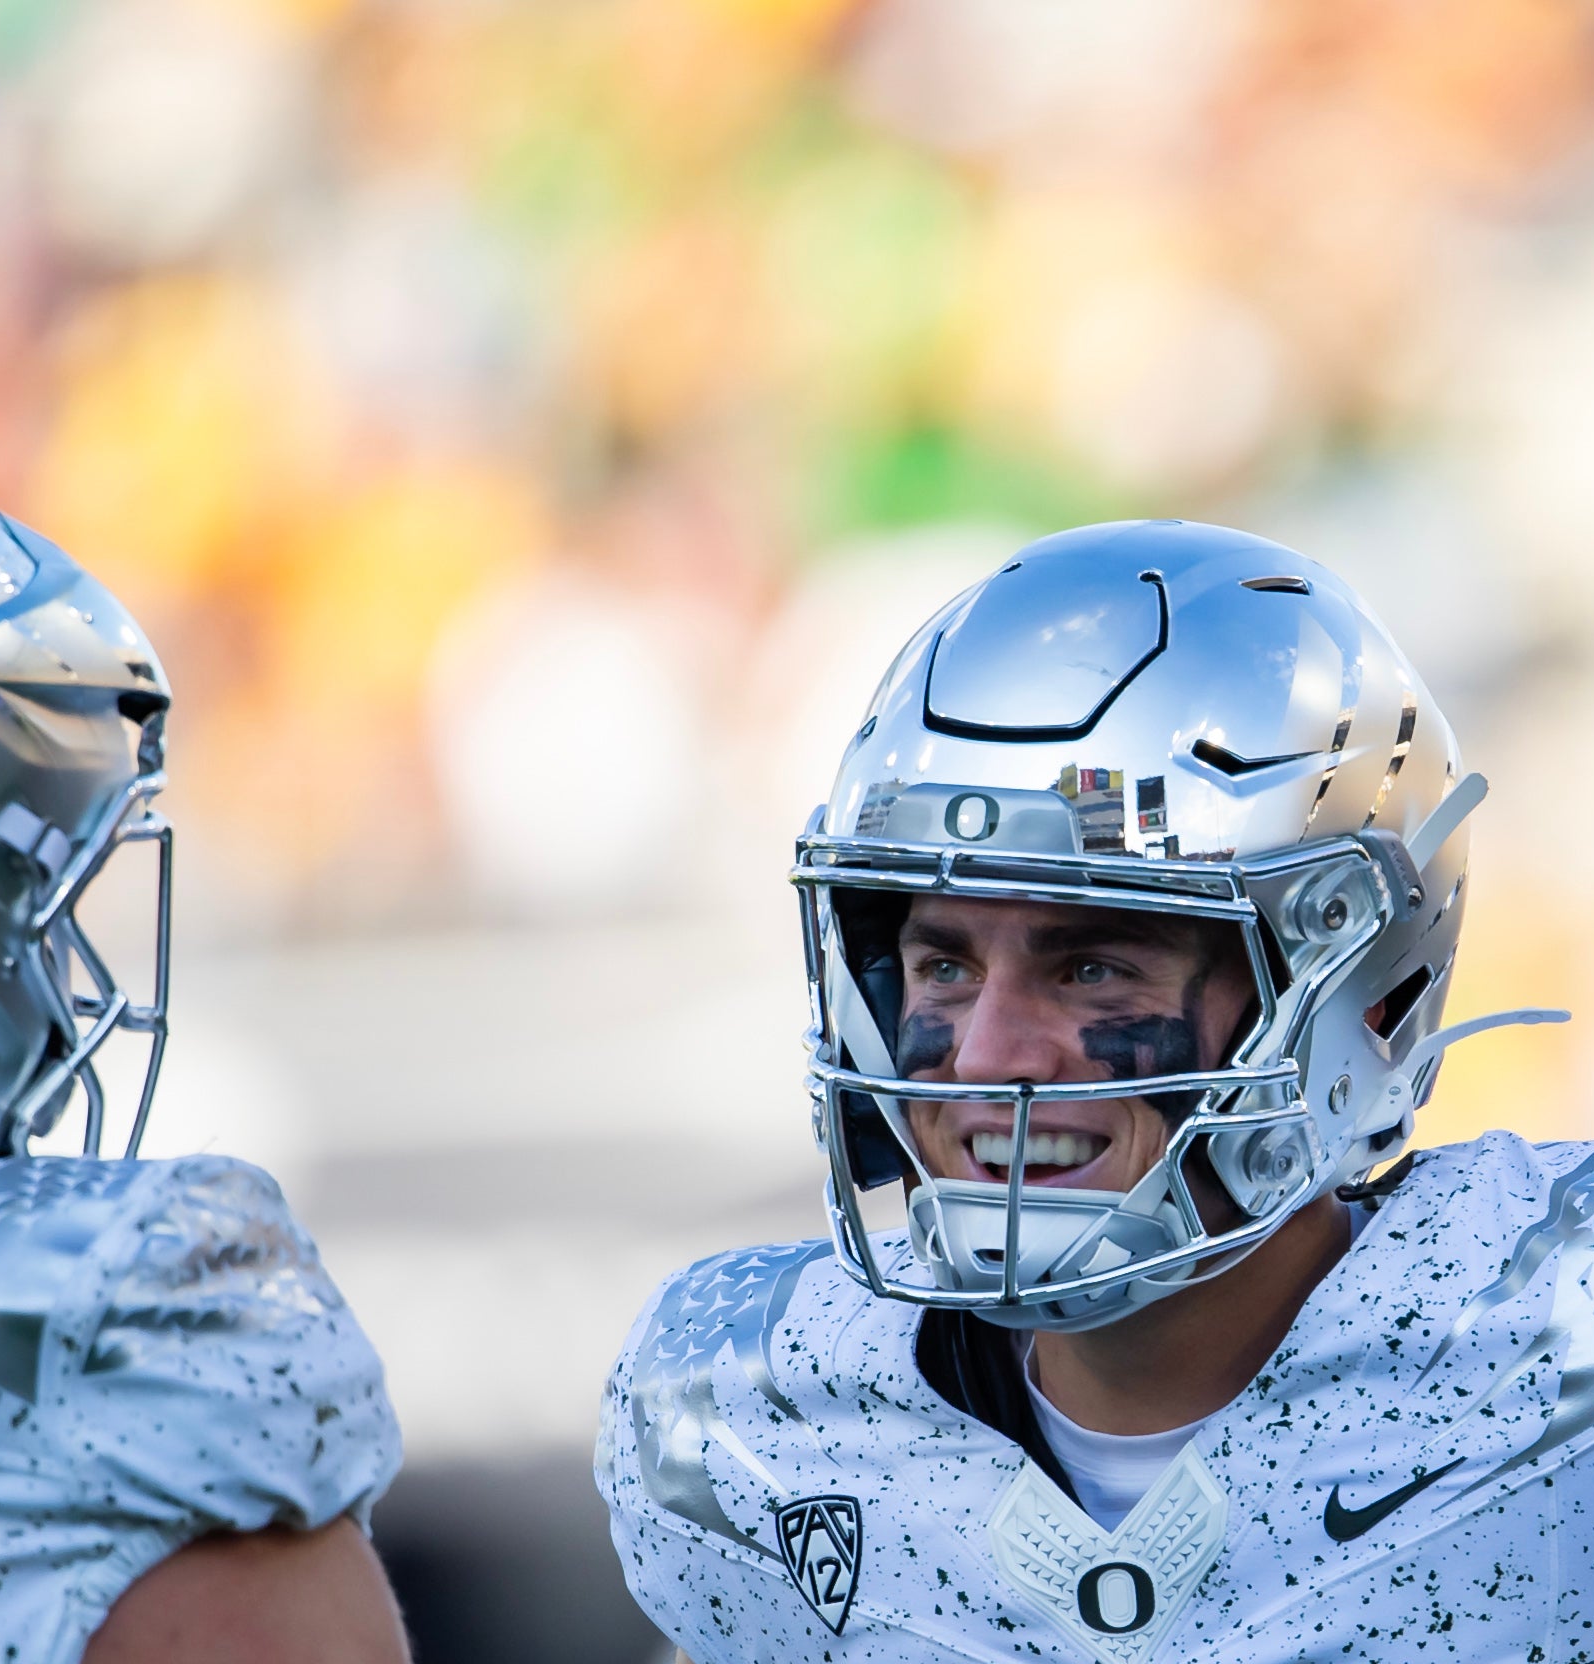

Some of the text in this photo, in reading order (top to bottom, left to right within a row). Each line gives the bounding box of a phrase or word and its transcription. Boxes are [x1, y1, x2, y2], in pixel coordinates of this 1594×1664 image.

[944, 792, 1001, 841] O
[781, 1502, 856, 1583] PAC
[807, 1556, 847, 1606] 12
[1077, 1562, 1156, 1634] O
